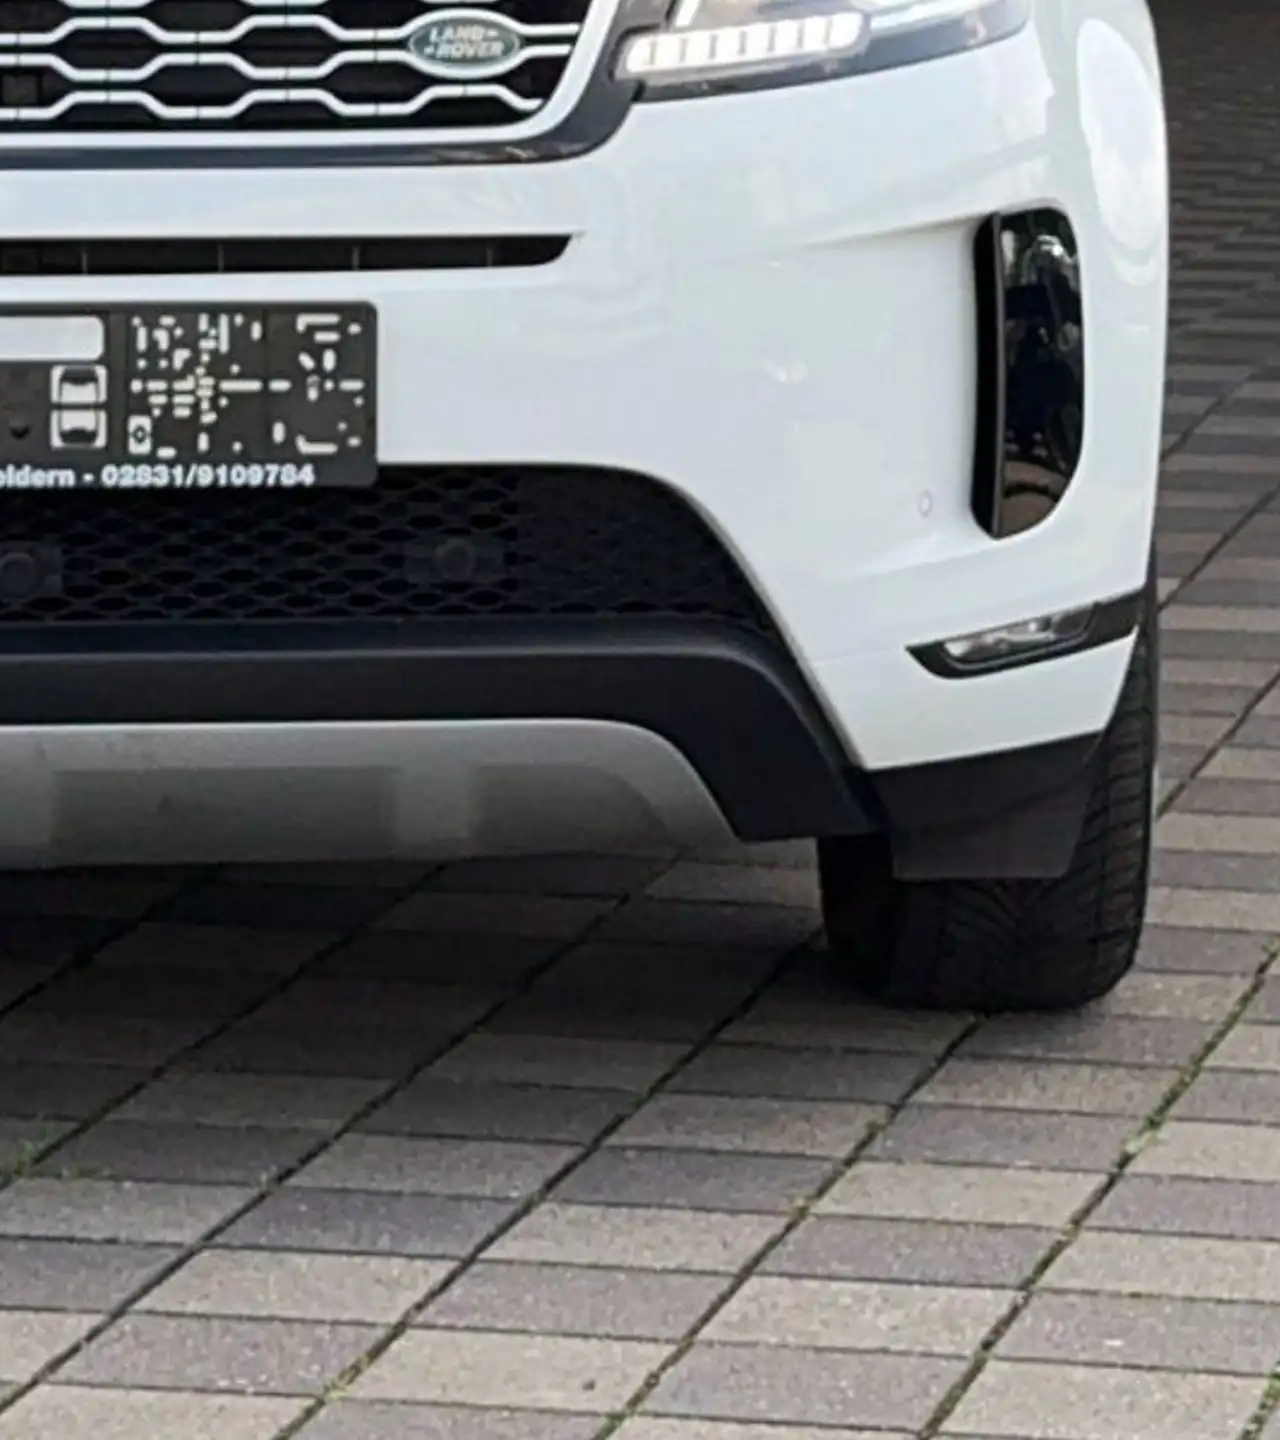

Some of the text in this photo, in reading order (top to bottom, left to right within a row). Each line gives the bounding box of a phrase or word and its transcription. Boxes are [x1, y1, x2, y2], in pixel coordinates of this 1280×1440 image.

[429, 24, 486, 42] LAND
[435, 41, 505, 59] ROVER
[100, 463, 316, 487] 02831/9109784
